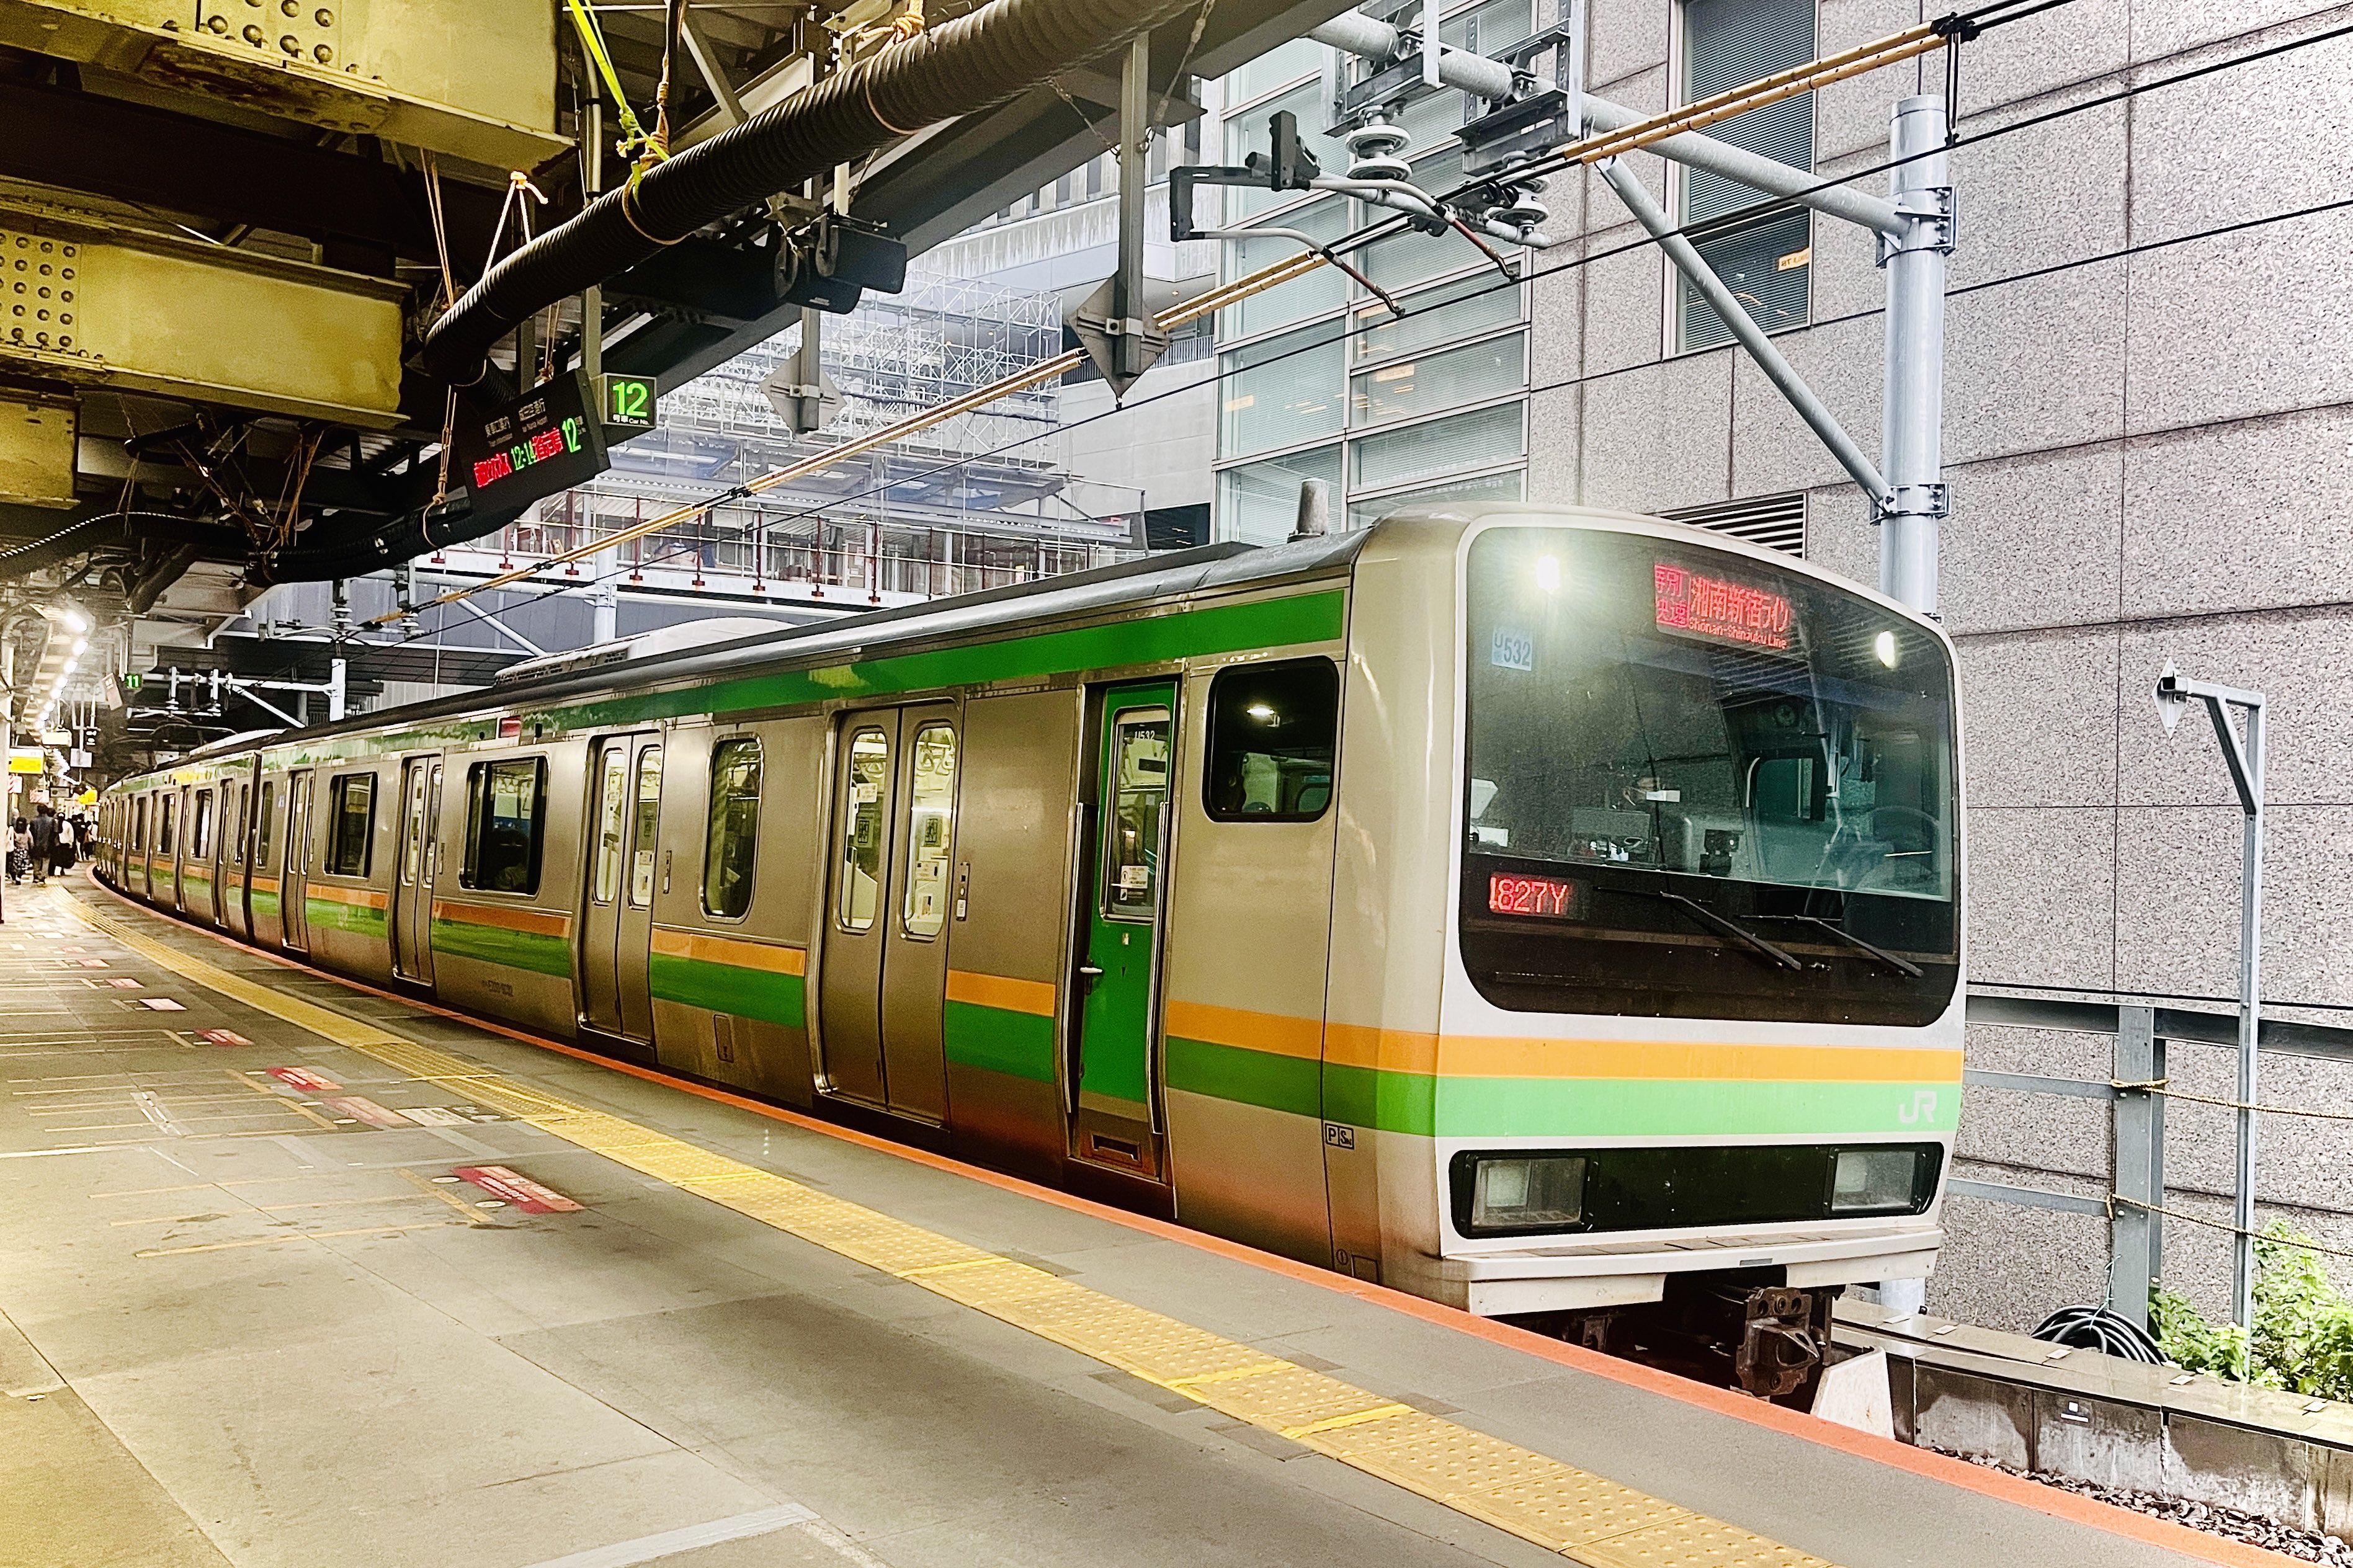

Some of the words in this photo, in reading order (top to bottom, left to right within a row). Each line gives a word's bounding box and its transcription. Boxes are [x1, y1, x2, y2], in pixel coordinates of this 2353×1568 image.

[612, 381, 648, 417] 12
[561, 417, 581, 453] 12
[1494, 633, 1530, 667] U532
[127, 675, 139, 688] 11
[1898, 1090, 1937, 1123] JR
